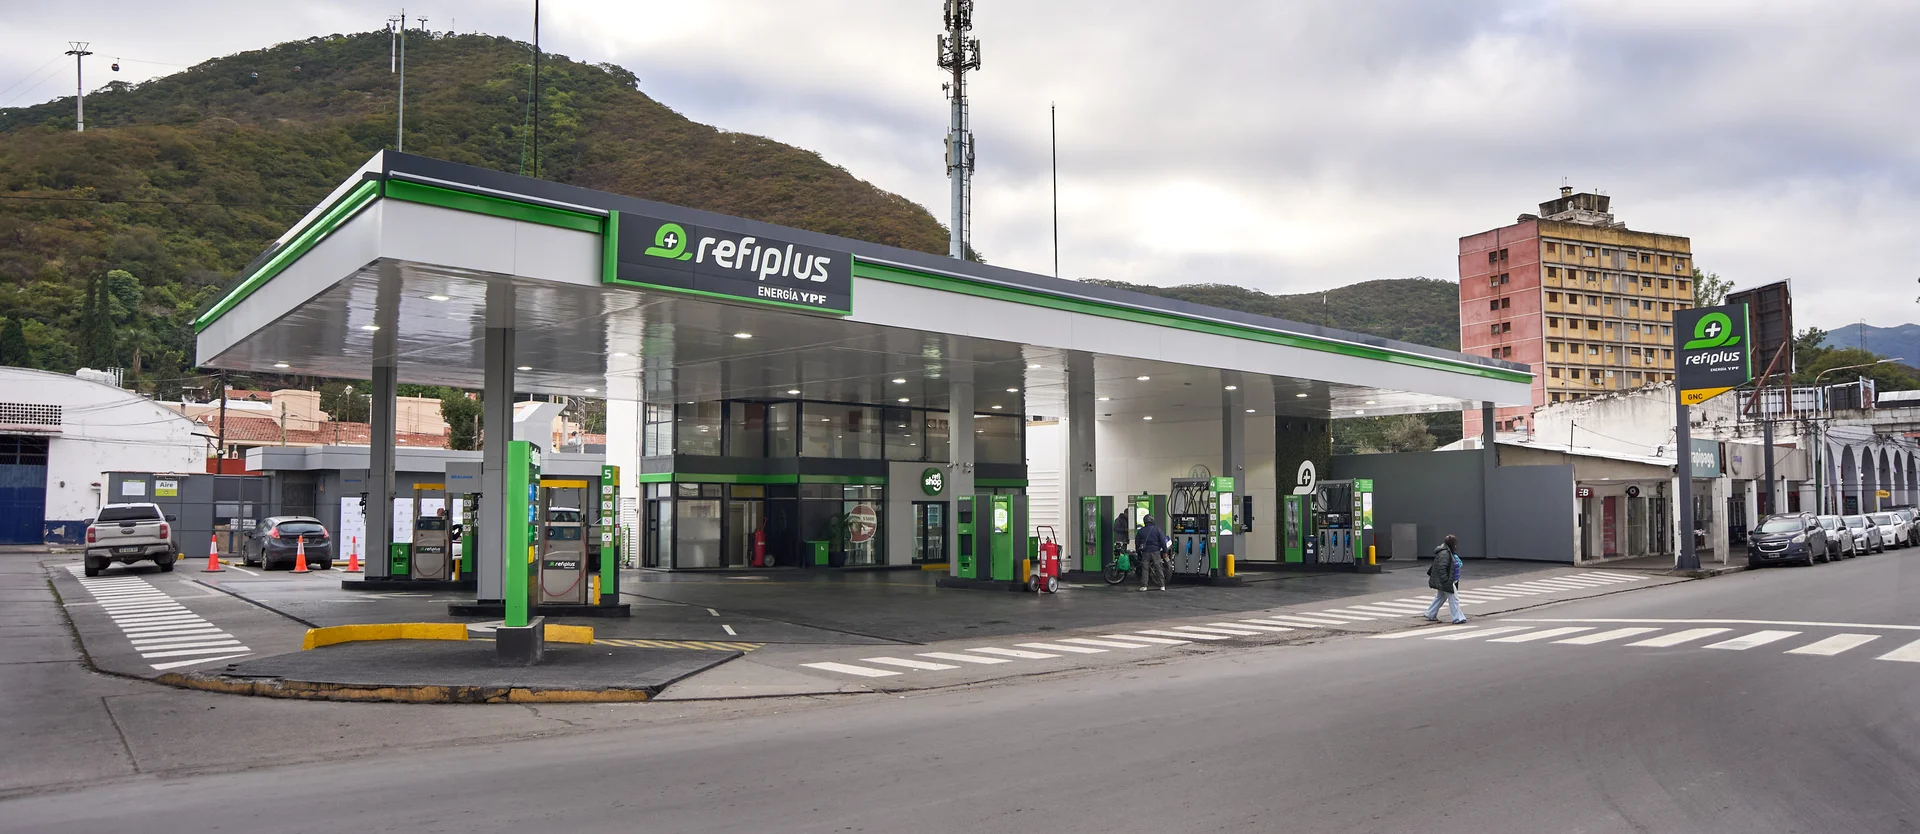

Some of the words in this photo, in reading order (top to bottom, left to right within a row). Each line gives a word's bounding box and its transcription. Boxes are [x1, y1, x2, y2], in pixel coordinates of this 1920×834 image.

[695, 236, 831, 283] refiplus
[758, 286, 798, 301] ENERGÍA
[800, 292, 827, 304] YPF
[1685, 351, 1741, 366] refiplus
[604, 469, 612, 479] 5
[925, 476, 942, 487] shop
